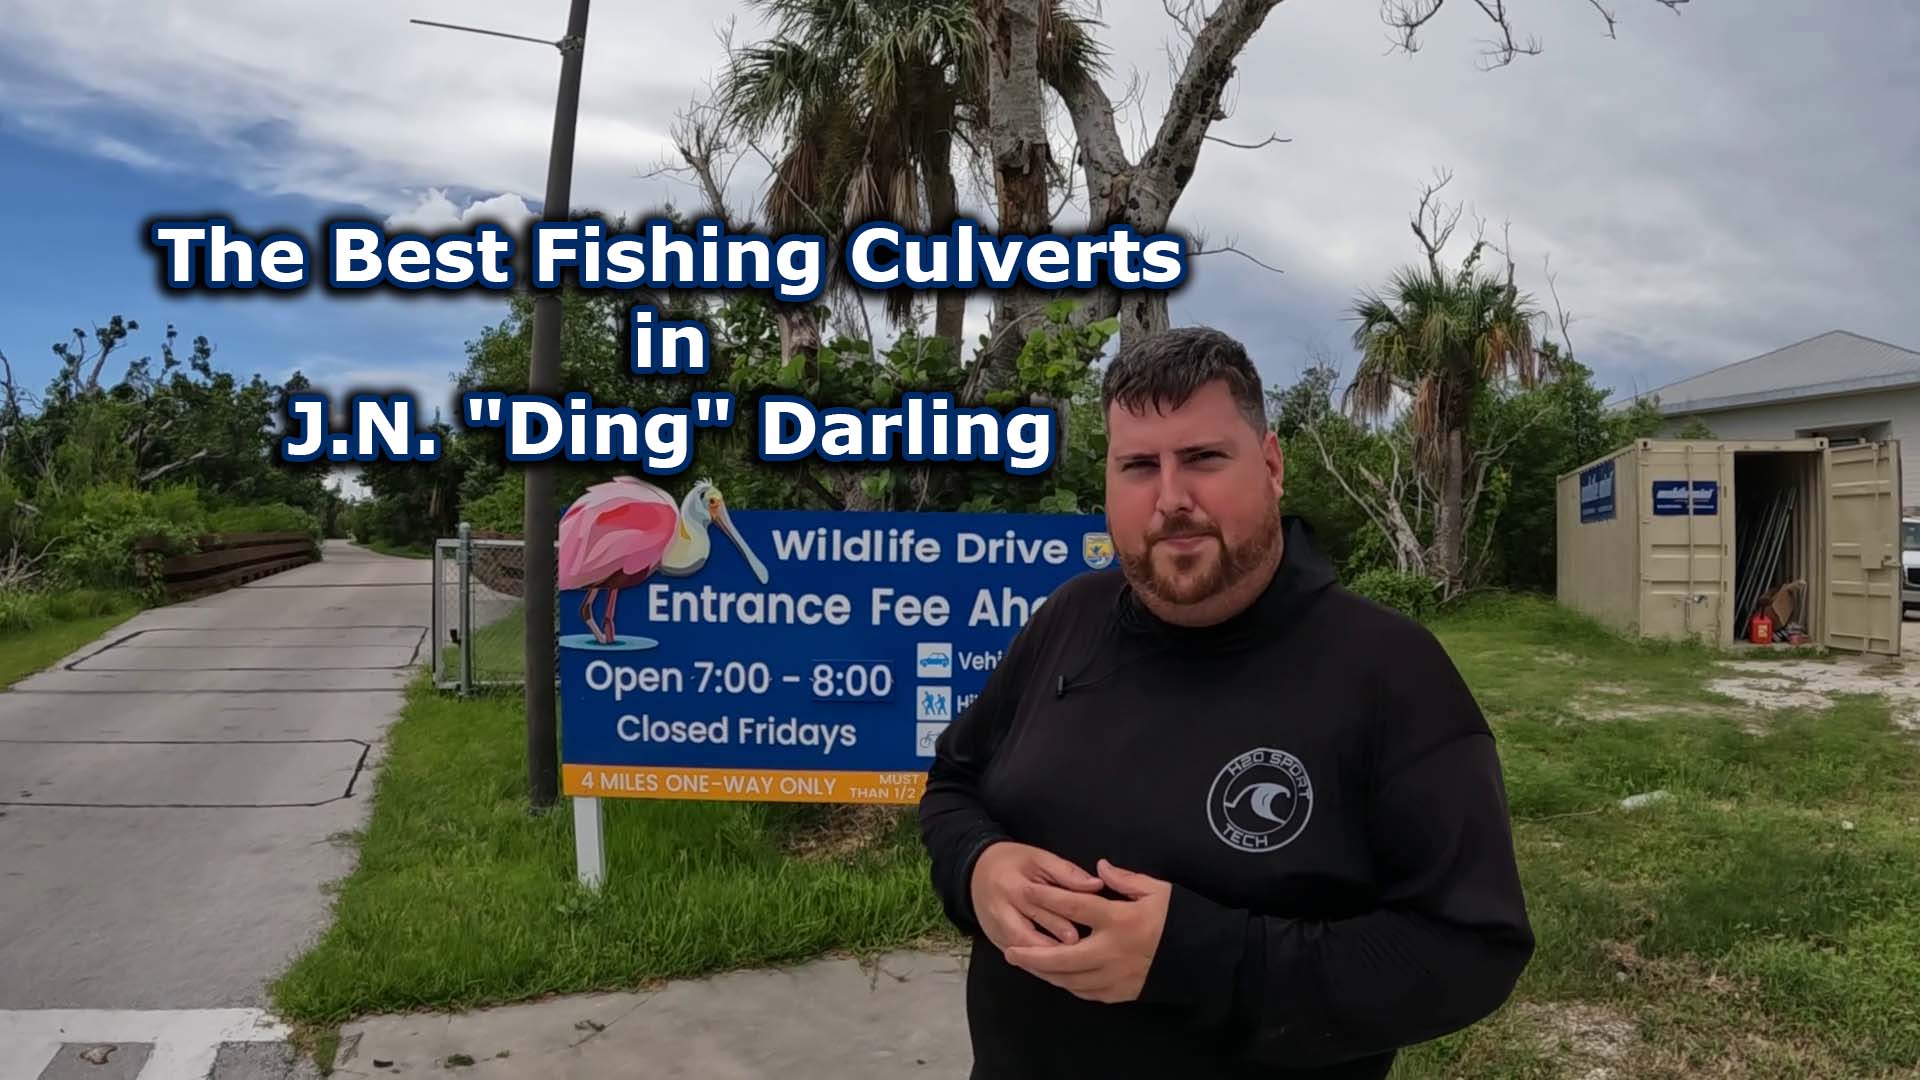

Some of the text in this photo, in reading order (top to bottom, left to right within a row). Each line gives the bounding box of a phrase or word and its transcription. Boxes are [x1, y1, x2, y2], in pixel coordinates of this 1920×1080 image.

[771, 527, 1069, 565] Wildlife Drive
[648, 583, 852, 626] Entrance
[871, 587, 951, 627] Fee
[585, 659, 684, 701] Open
[693, 661, 771, 694] 7:00
[811, 664, 893, 697] 8:00
[616, 714, 858, 755] Closed Fridays
[580, 771, 837, 796] 4 MILES ONE-WAY ONLY
[849, 785, 916, 800] THAN 1/2
[879, 774, 920, 785] MUST
[1269, 752, 1311, 800] SPORT
[1222, 822, 1269, 848] TECH
